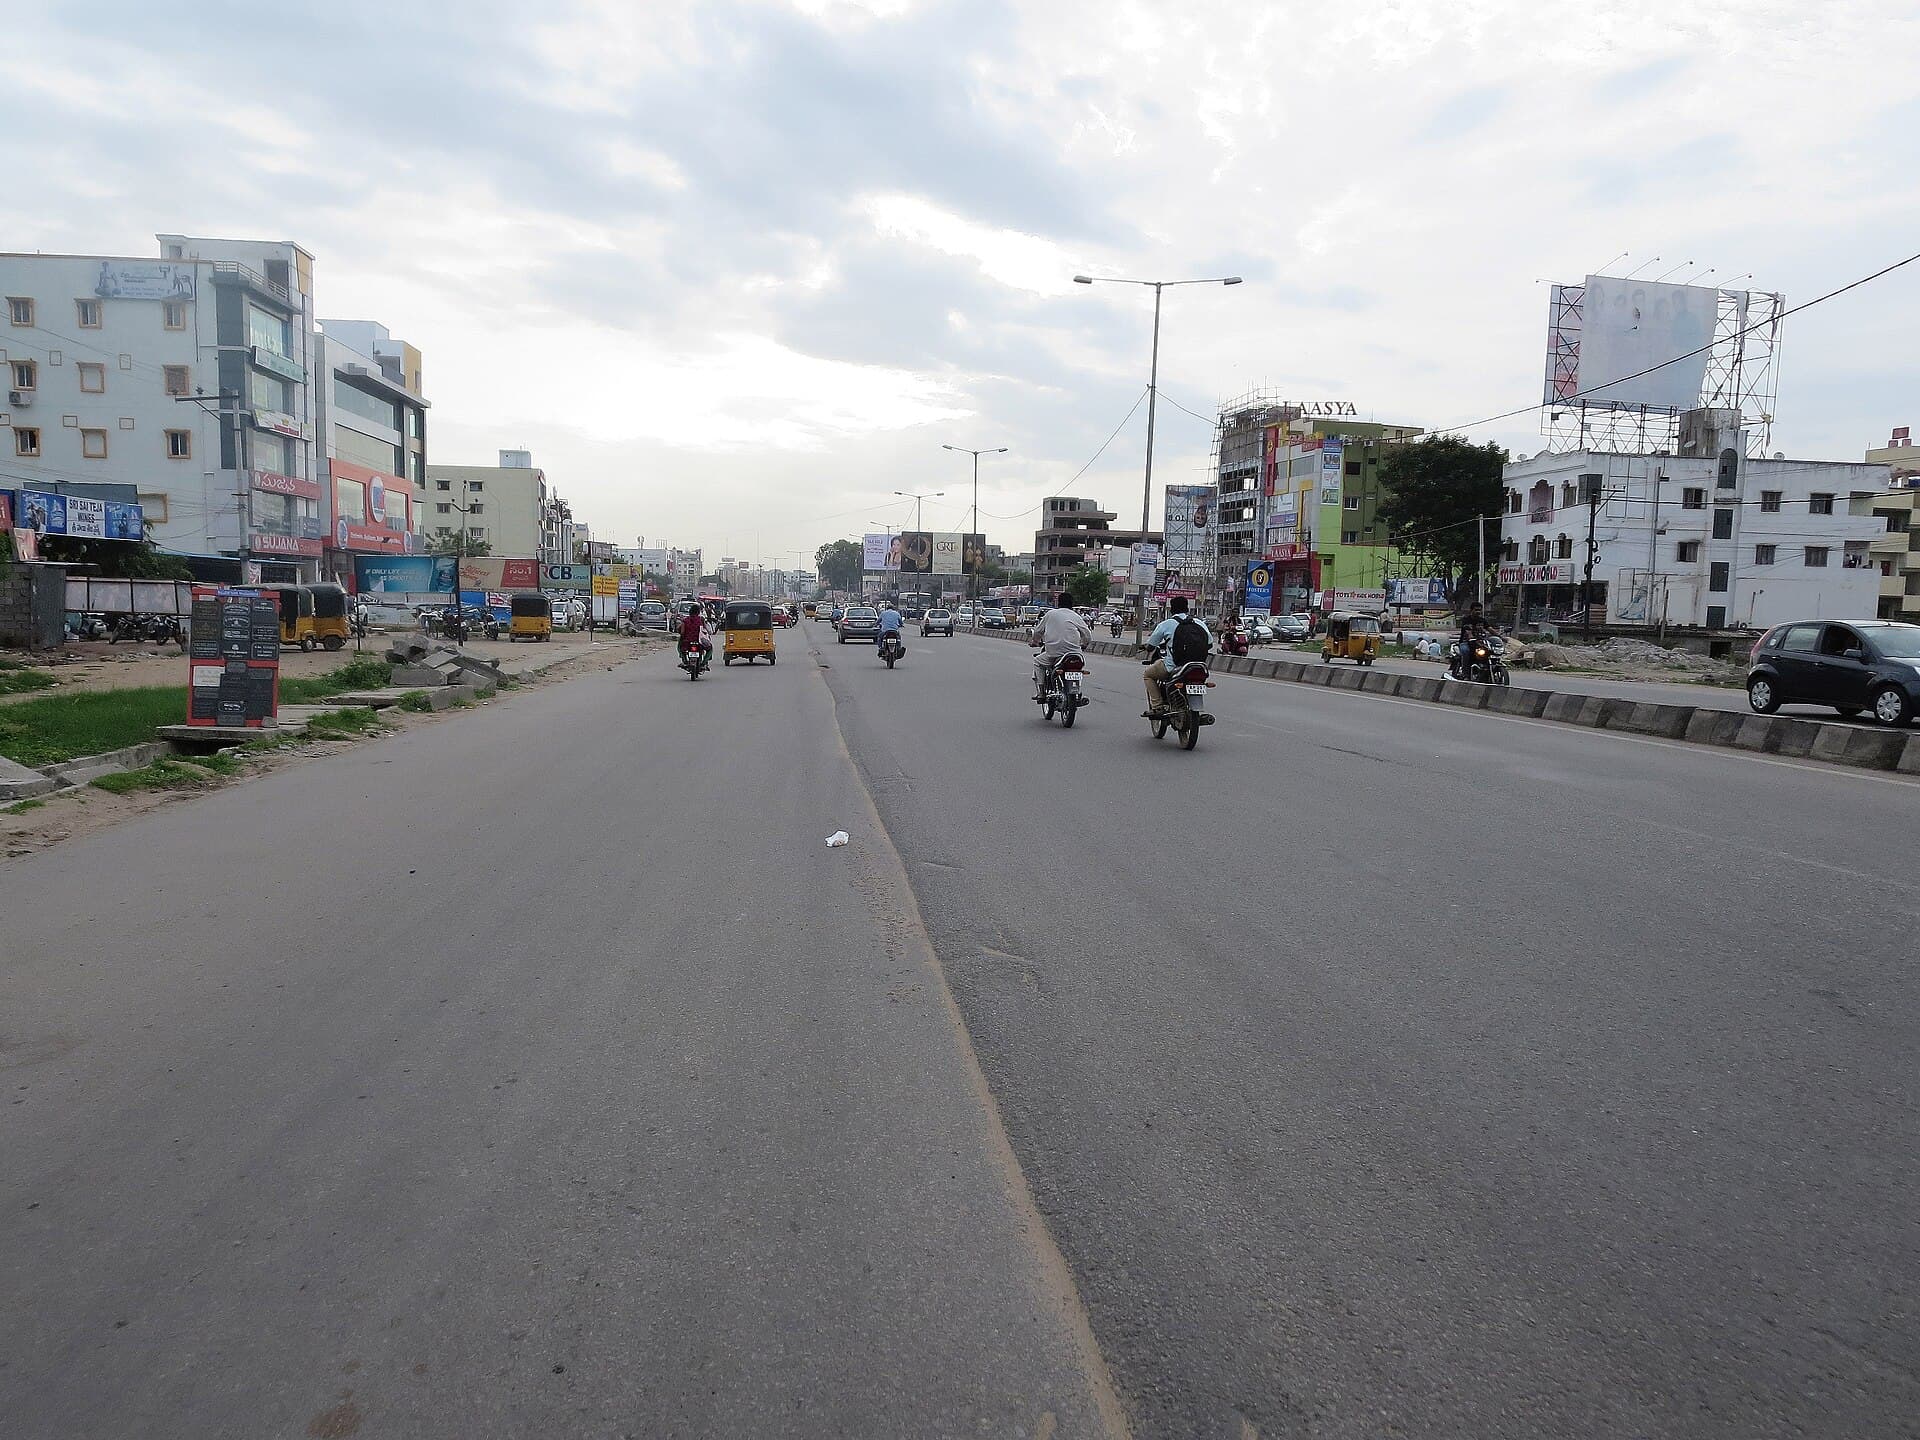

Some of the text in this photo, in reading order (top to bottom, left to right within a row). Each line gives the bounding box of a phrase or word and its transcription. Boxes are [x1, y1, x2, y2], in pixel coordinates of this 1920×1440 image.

[1283, 401, 1358, 416] LAASYA
[70, 499, 103, 512] SRI SAI TEJA
[263, 536, 299, 551] SUJANA
